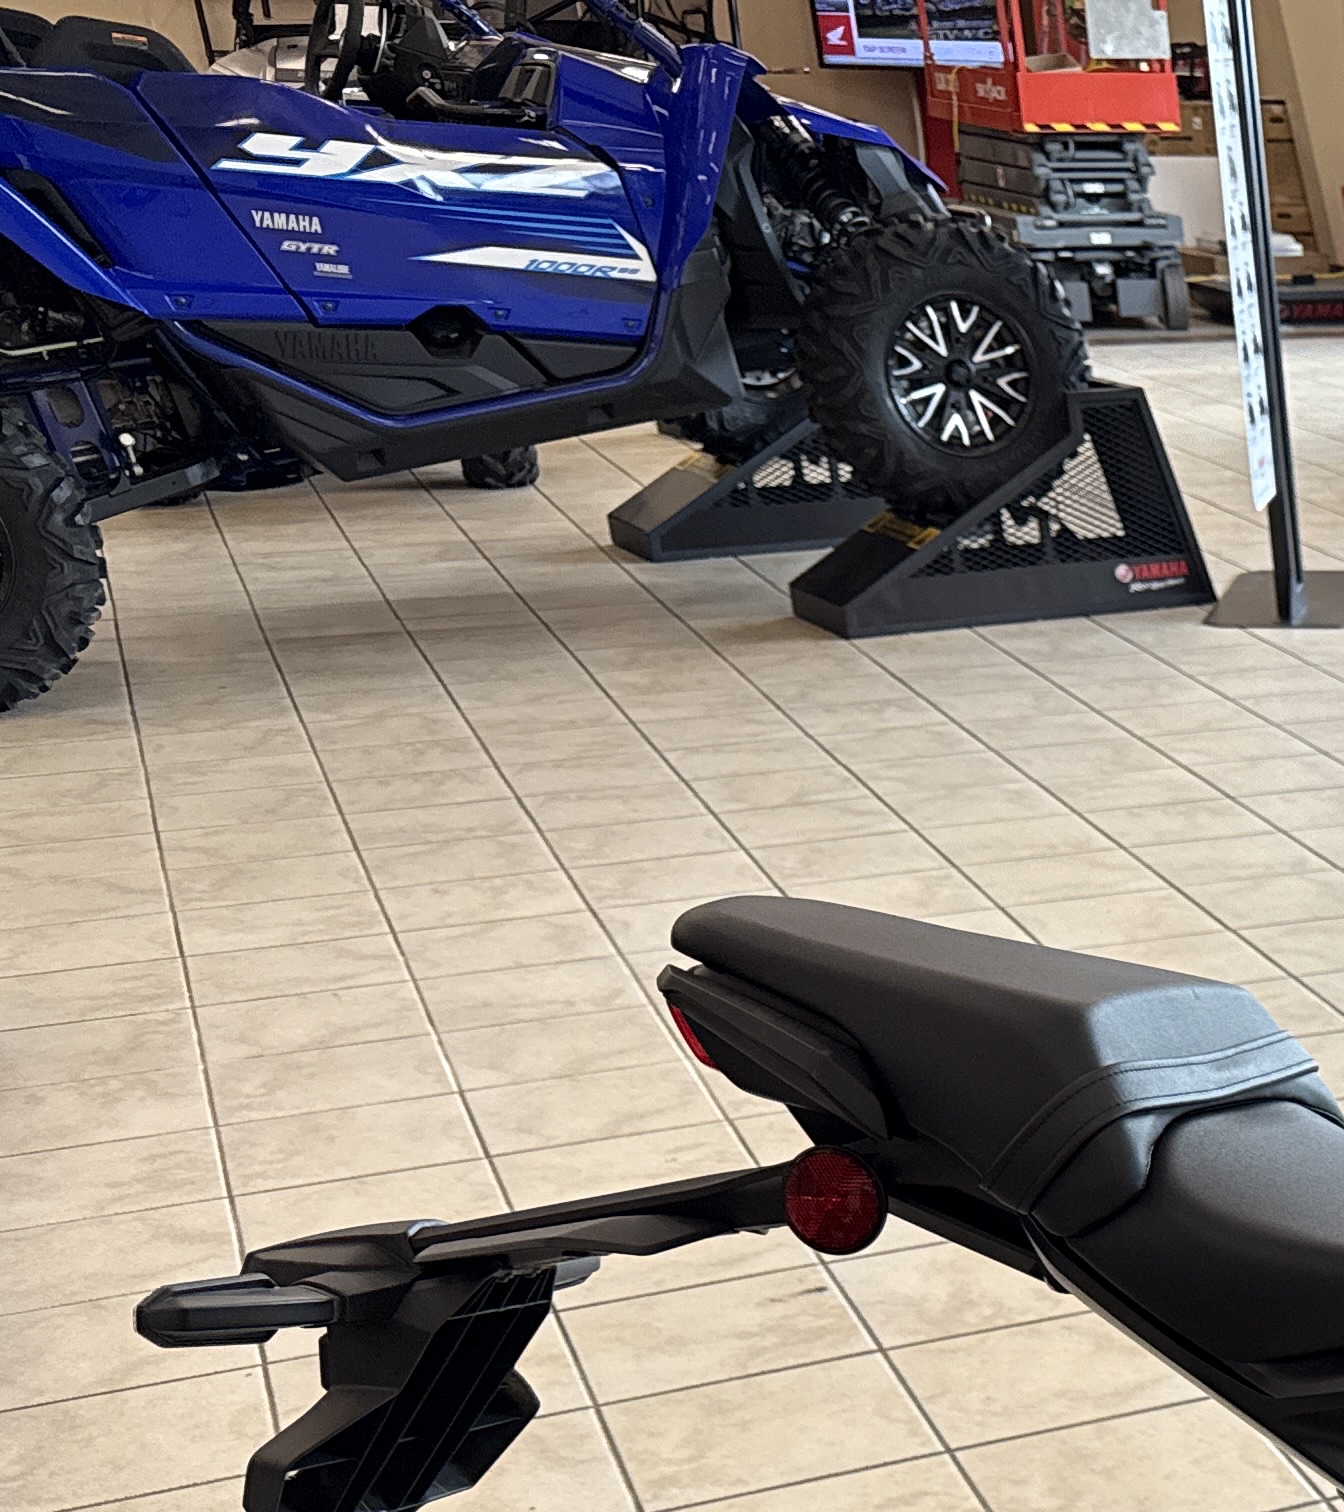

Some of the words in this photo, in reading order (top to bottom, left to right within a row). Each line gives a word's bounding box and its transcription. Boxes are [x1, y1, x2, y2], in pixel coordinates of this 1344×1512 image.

[251, 210, 323, 235] YAMAHA
[280, 240, 340, 256] GYTR
[523, 258, 617, 279] 1000R
